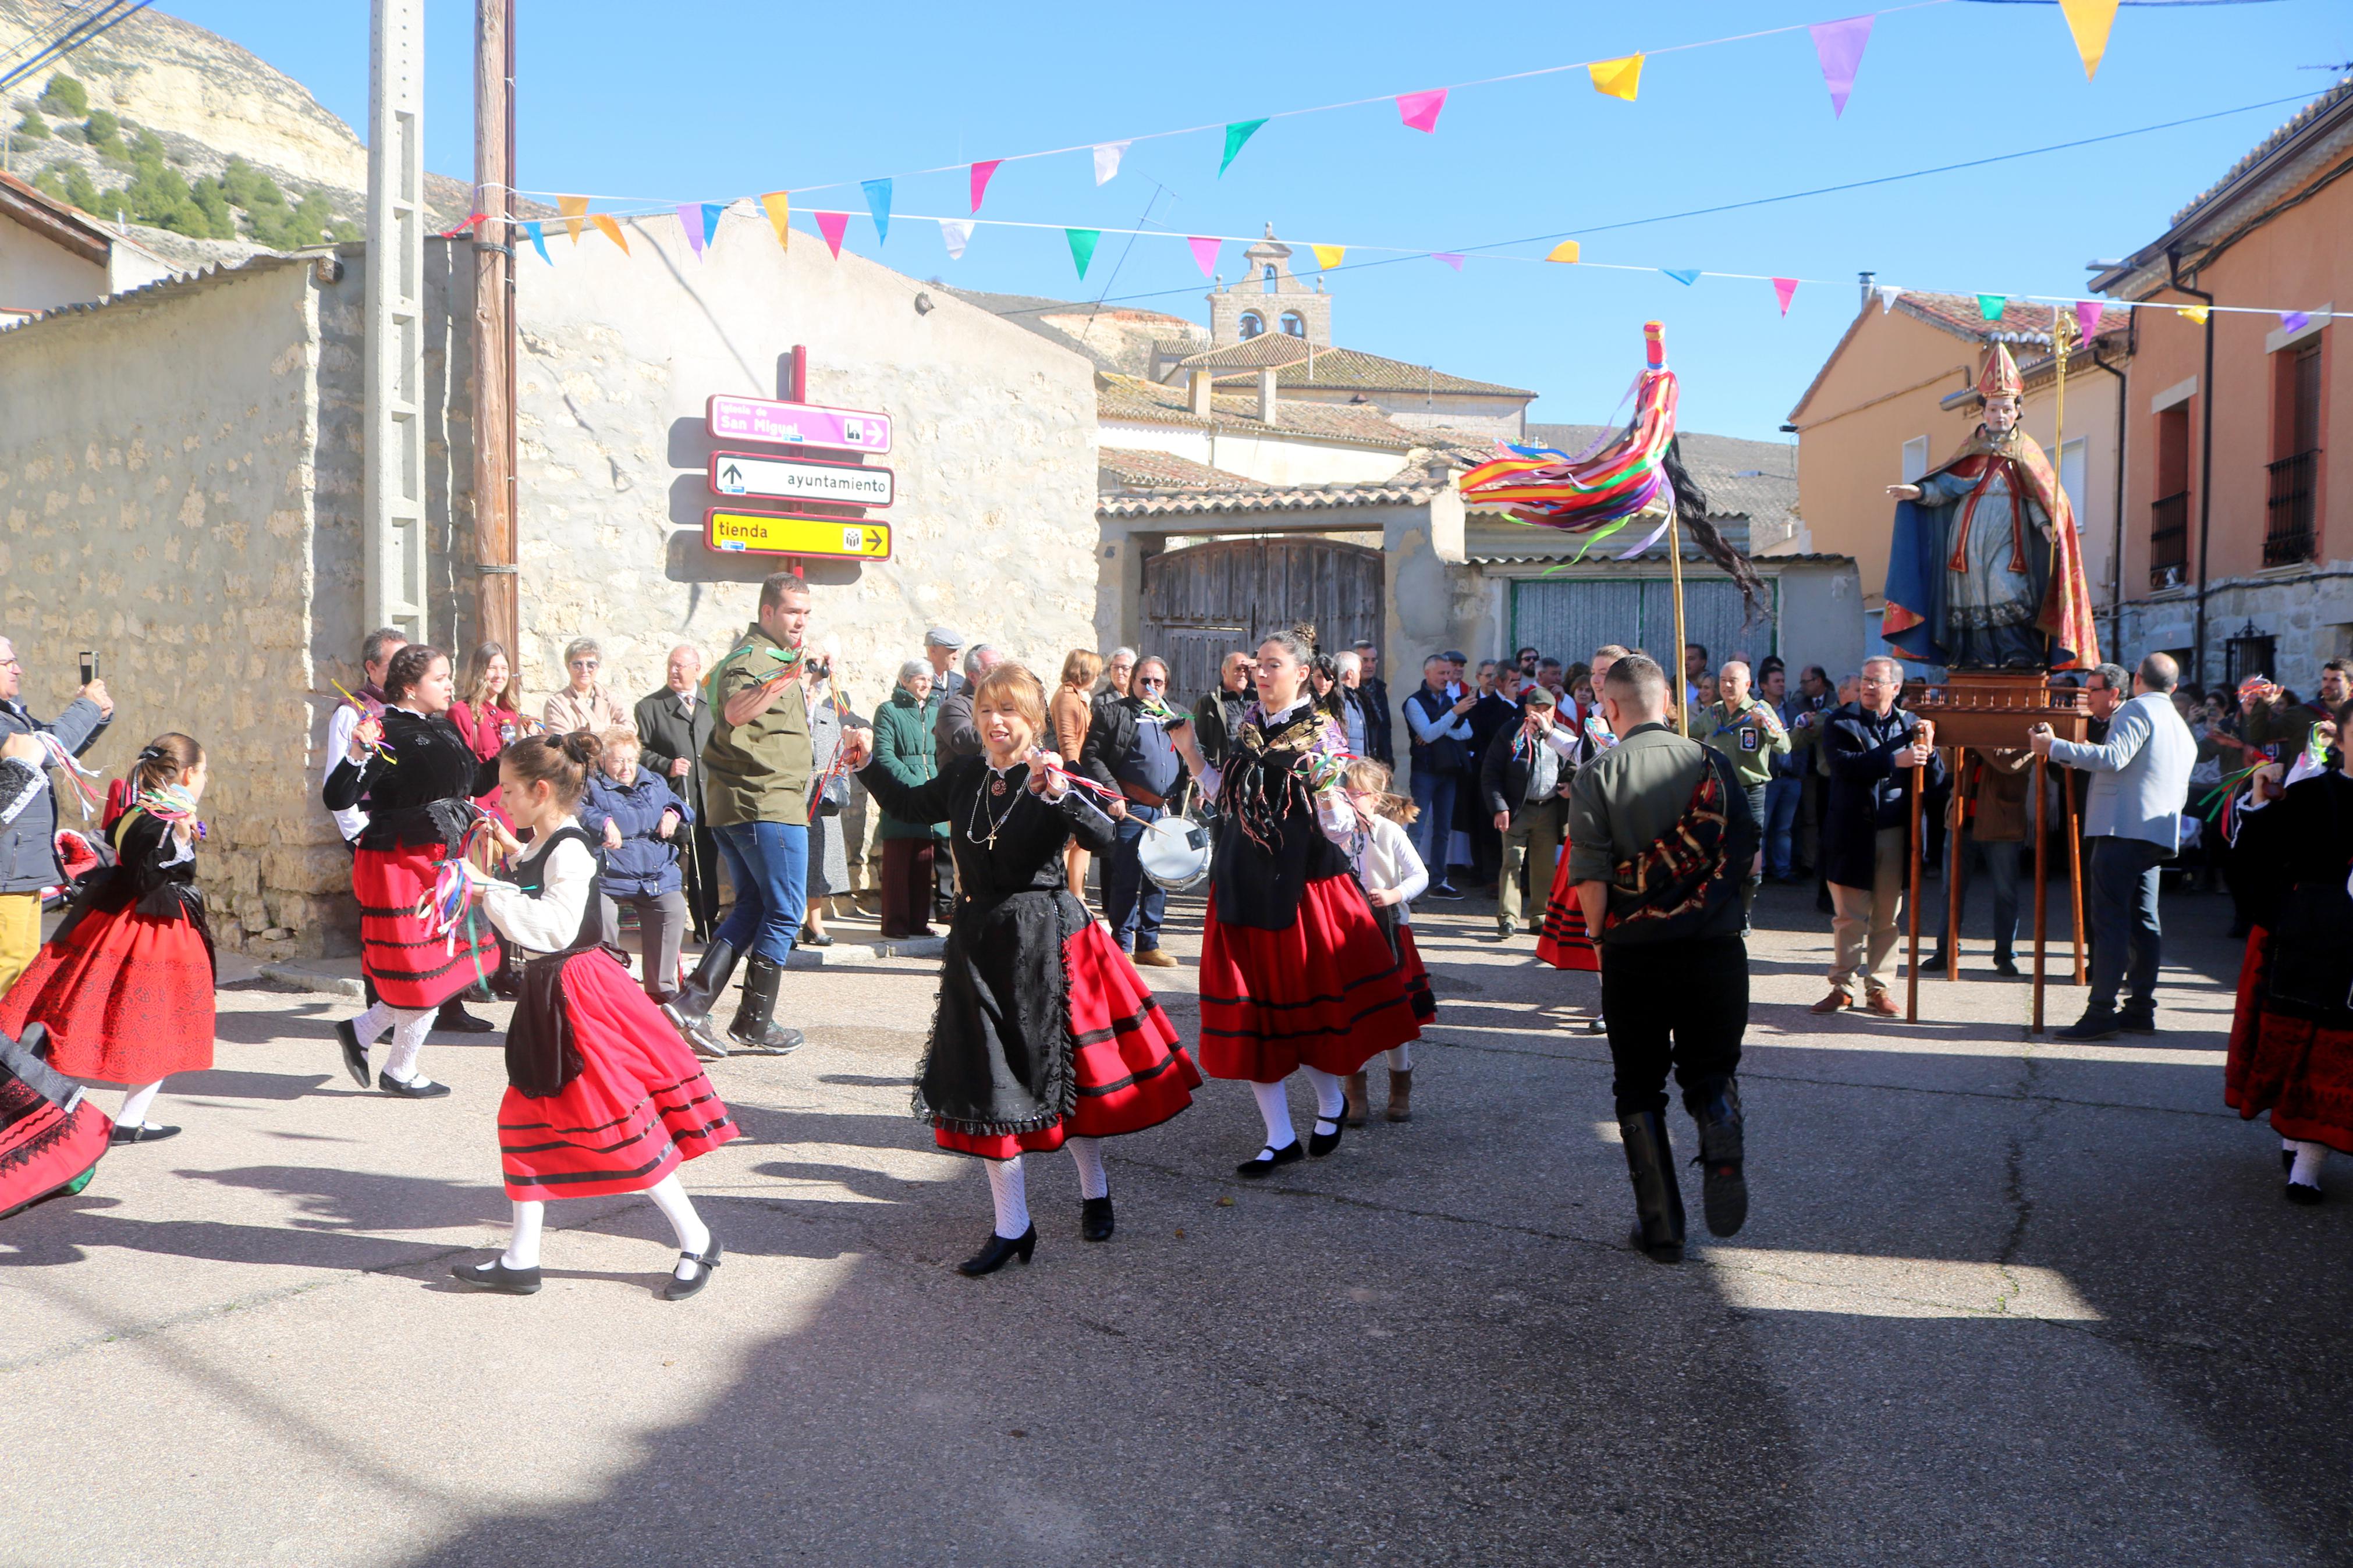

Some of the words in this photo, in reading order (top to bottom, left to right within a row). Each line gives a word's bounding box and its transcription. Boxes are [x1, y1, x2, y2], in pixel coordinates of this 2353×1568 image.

[721, 403, 750, 415] Iglesia
[755, 407, 767, 417] de
[721, 415, 747, 430] San
[754, 418, 798, 436] Miguel
[787, 475, 885, 492] ayuntamiento
[719, 521, 767, 538] tienda
